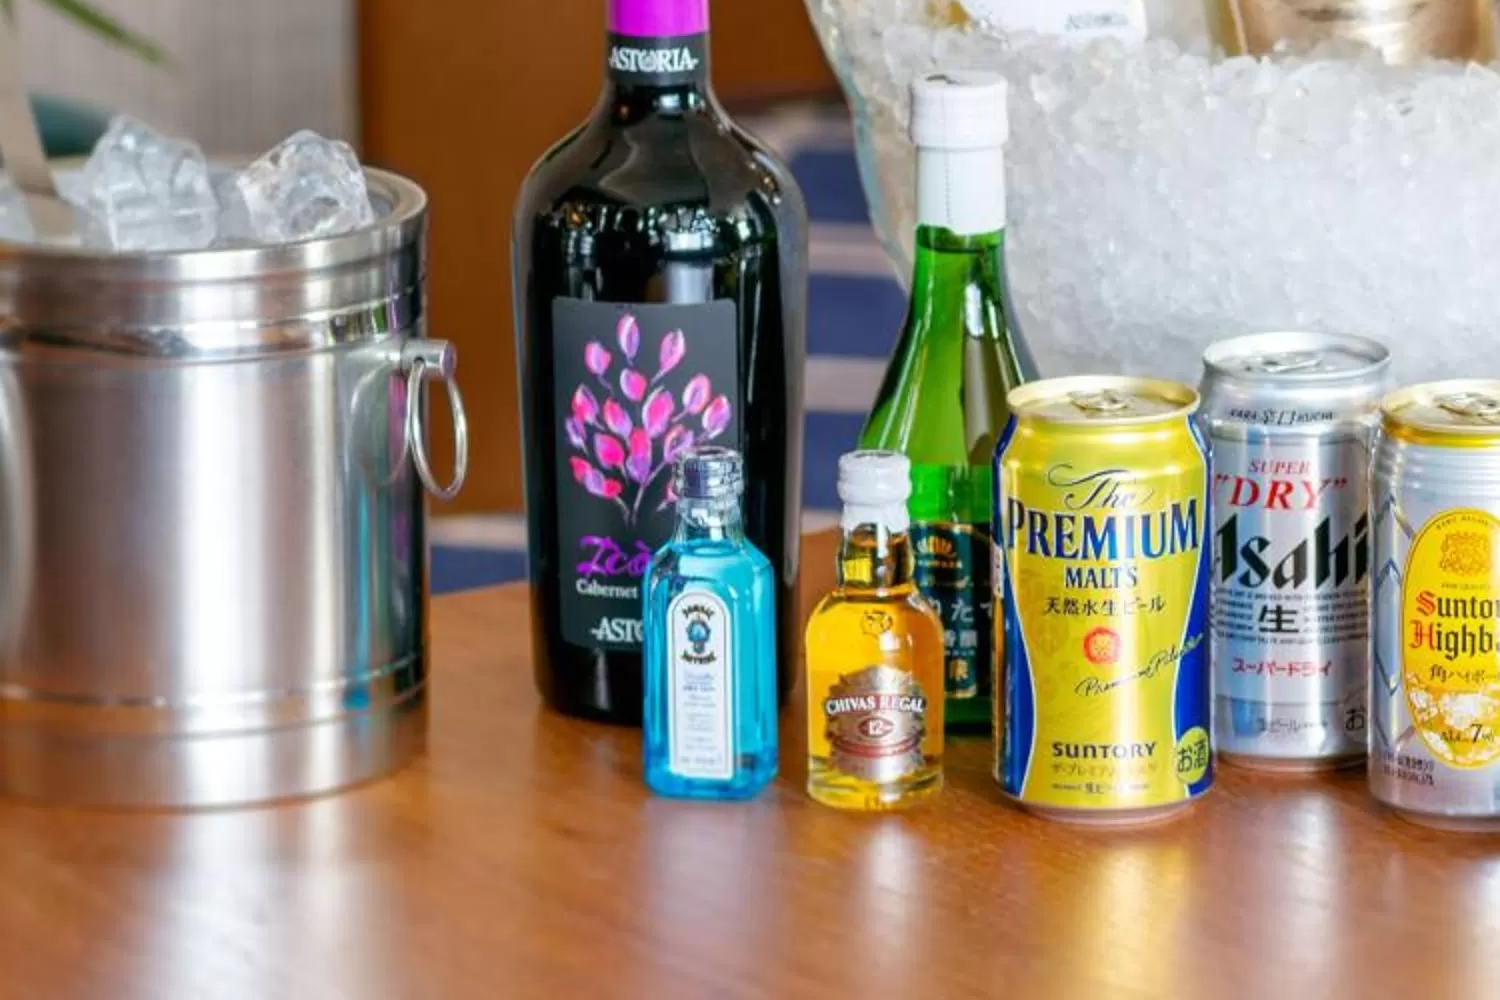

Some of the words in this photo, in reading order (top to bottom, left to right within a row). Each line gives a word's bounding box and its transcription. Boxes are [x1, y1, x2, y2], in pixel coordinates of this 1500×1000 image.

[609, 46, 698, 73] ASTORIA
[1248, 459, 1312, 475] SUPER
[1047, 463, 1154, 510] The
[1006, 496, 1200, 561] PREMIUM
[1215, 512, 1369, 590] Asahi
[576, 578, 639, 599] Cabernet
[1044, 595, 1166, 617] 天然水生ビール
[1258, 605, 1299, 633] 生
[826, 696, 876, 715] CHIVAS
